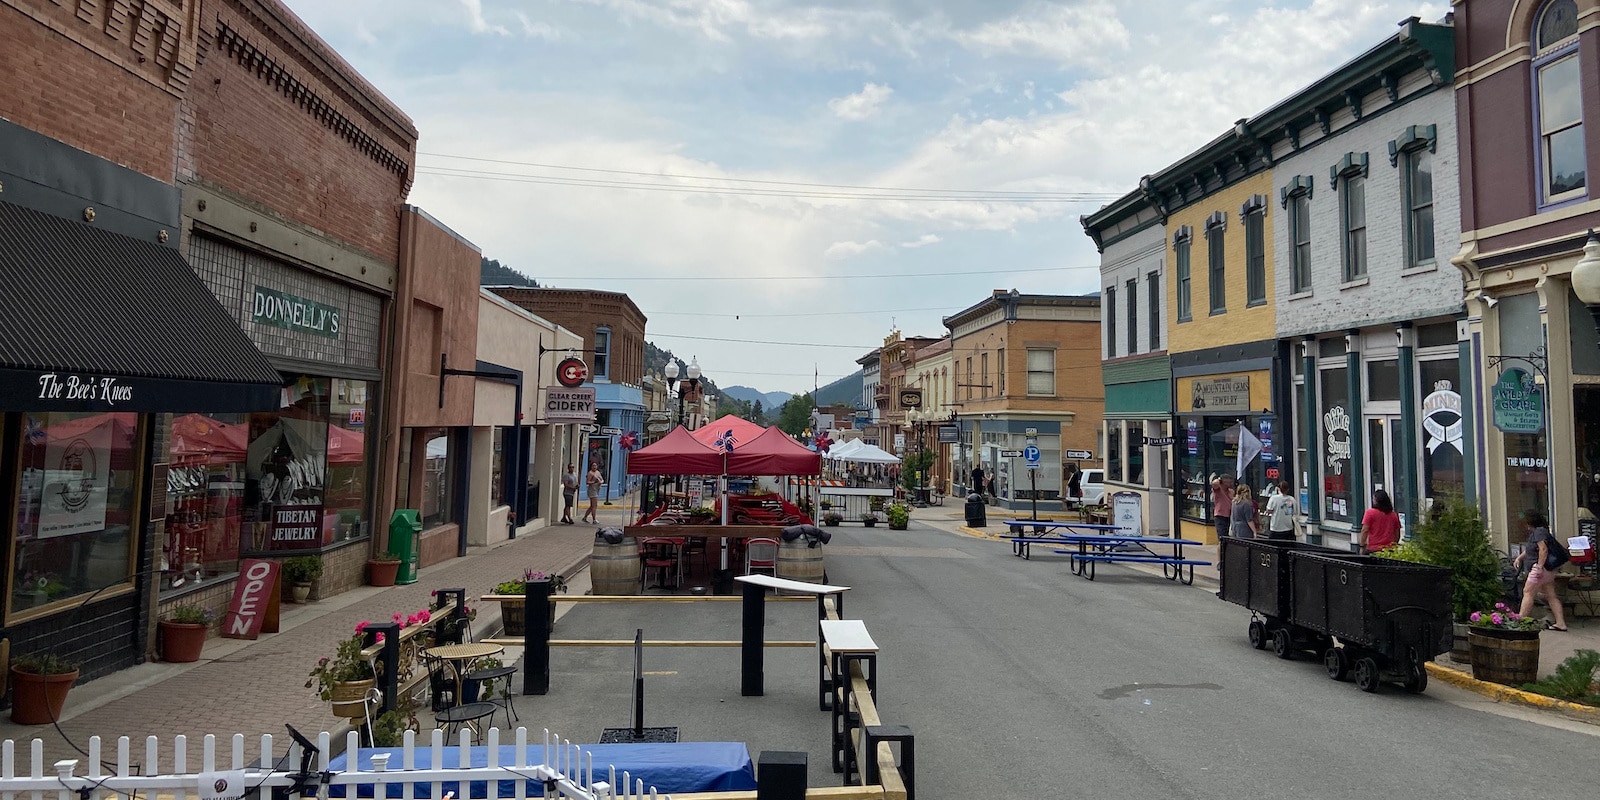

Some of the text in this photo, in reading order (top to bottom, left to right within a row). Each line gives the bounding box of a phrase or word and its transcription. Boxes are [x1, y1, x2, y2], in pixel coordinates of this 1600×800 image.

[253, 292, 339, 333] DONNELLY'S
[39, 372, 132, 405] The Bee's Knees
[1203, 382, 1232, 393] MOUNTAIN
[1501, 381, 1515, 389] THE
[572, 393, 592, 402] CREEK
[1212, 395, 1238, 406] JEWELRY
[1496, 390, 1525, 401] WILD
[548, 400, 592, 411] CIDERY
[1500, 400, 1536, 412] GRAPE
[1324, 406, 1350, 434] Offic
[1328, 434, 1351, 459] Suppl
[1027, 447, 1038, 460] P
[1507, 458, 1549, 468] THE WILD GRA
[277, 510, 316, 523] TIBETAN
[272, 527, 317, 541] JEWELRY
[231, 562, 271, 635] OPEN
